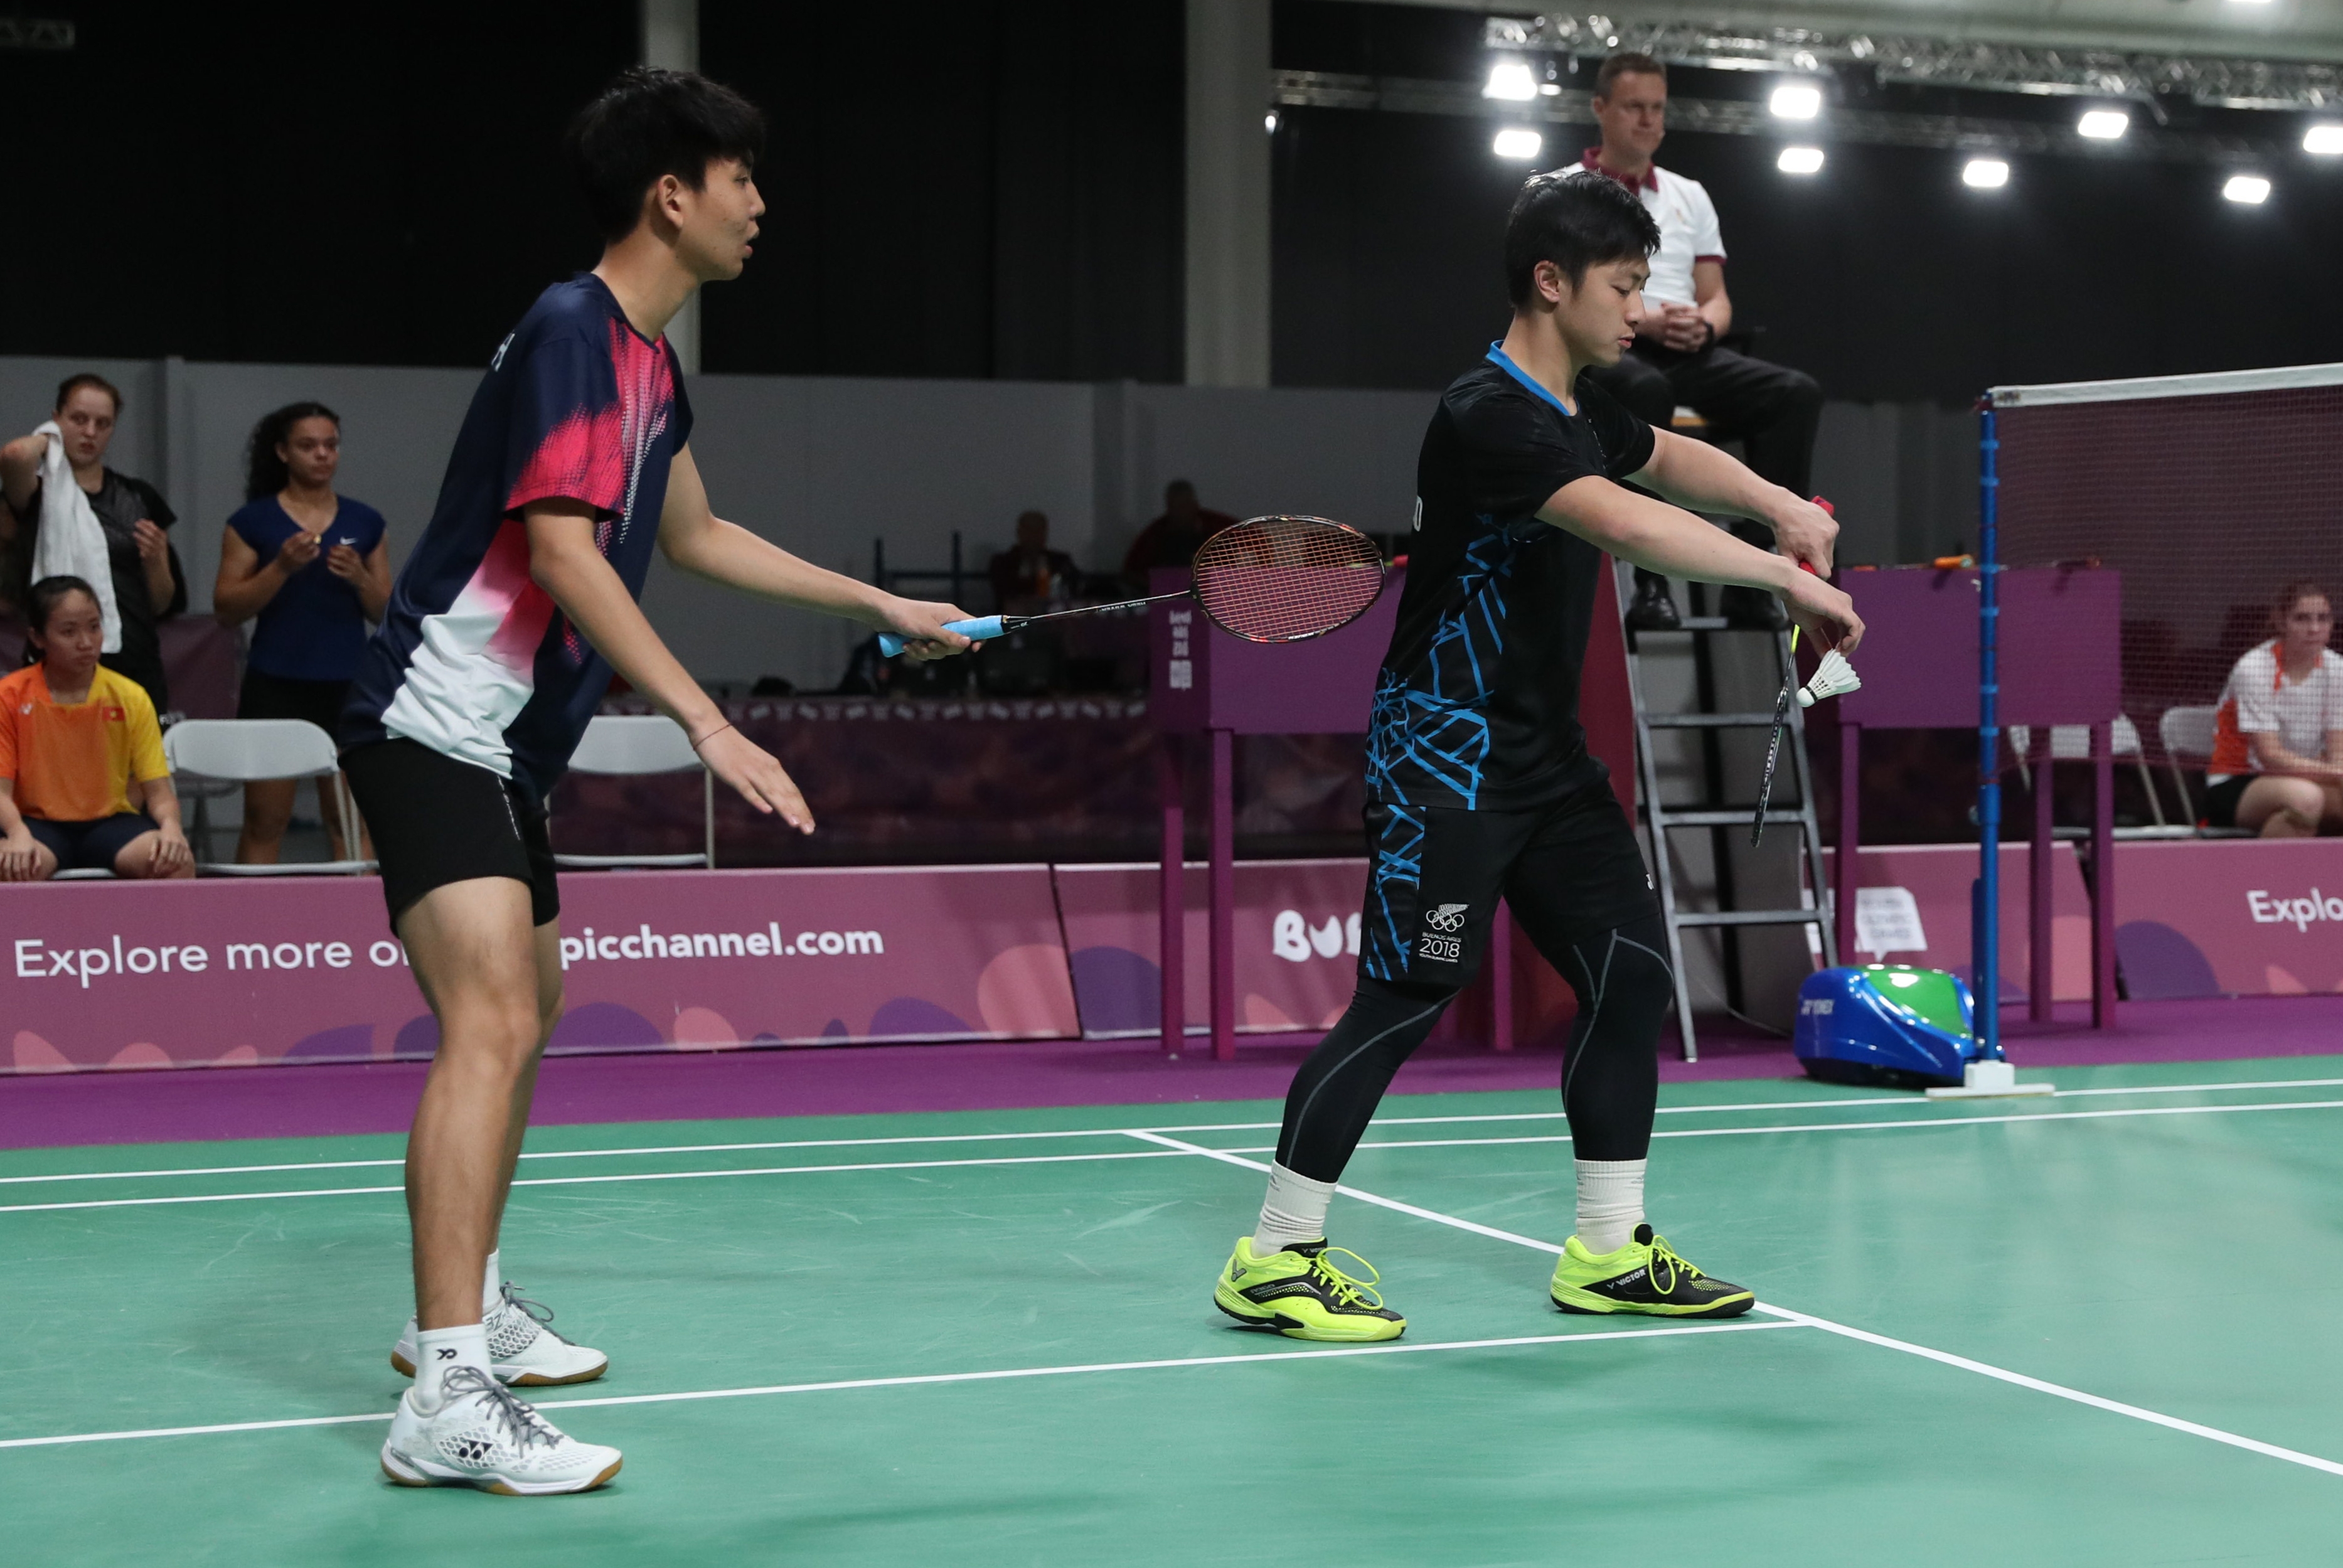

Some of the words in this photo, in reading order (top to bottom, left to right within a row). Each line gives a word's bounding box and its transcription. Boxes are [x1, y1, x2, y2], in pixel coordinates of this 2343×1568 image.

[2246, 887, 2343, 933] Explo
[14, 934, 209, 989] Explore
[226, 941, 353, 971] more
[369, 940, 410, 968] o
[560, 921, 884, 971] picchannel.com
[1419, 938, 1460, 957] 2018
[1616, 1269, 1647, 1286] VICTOR
